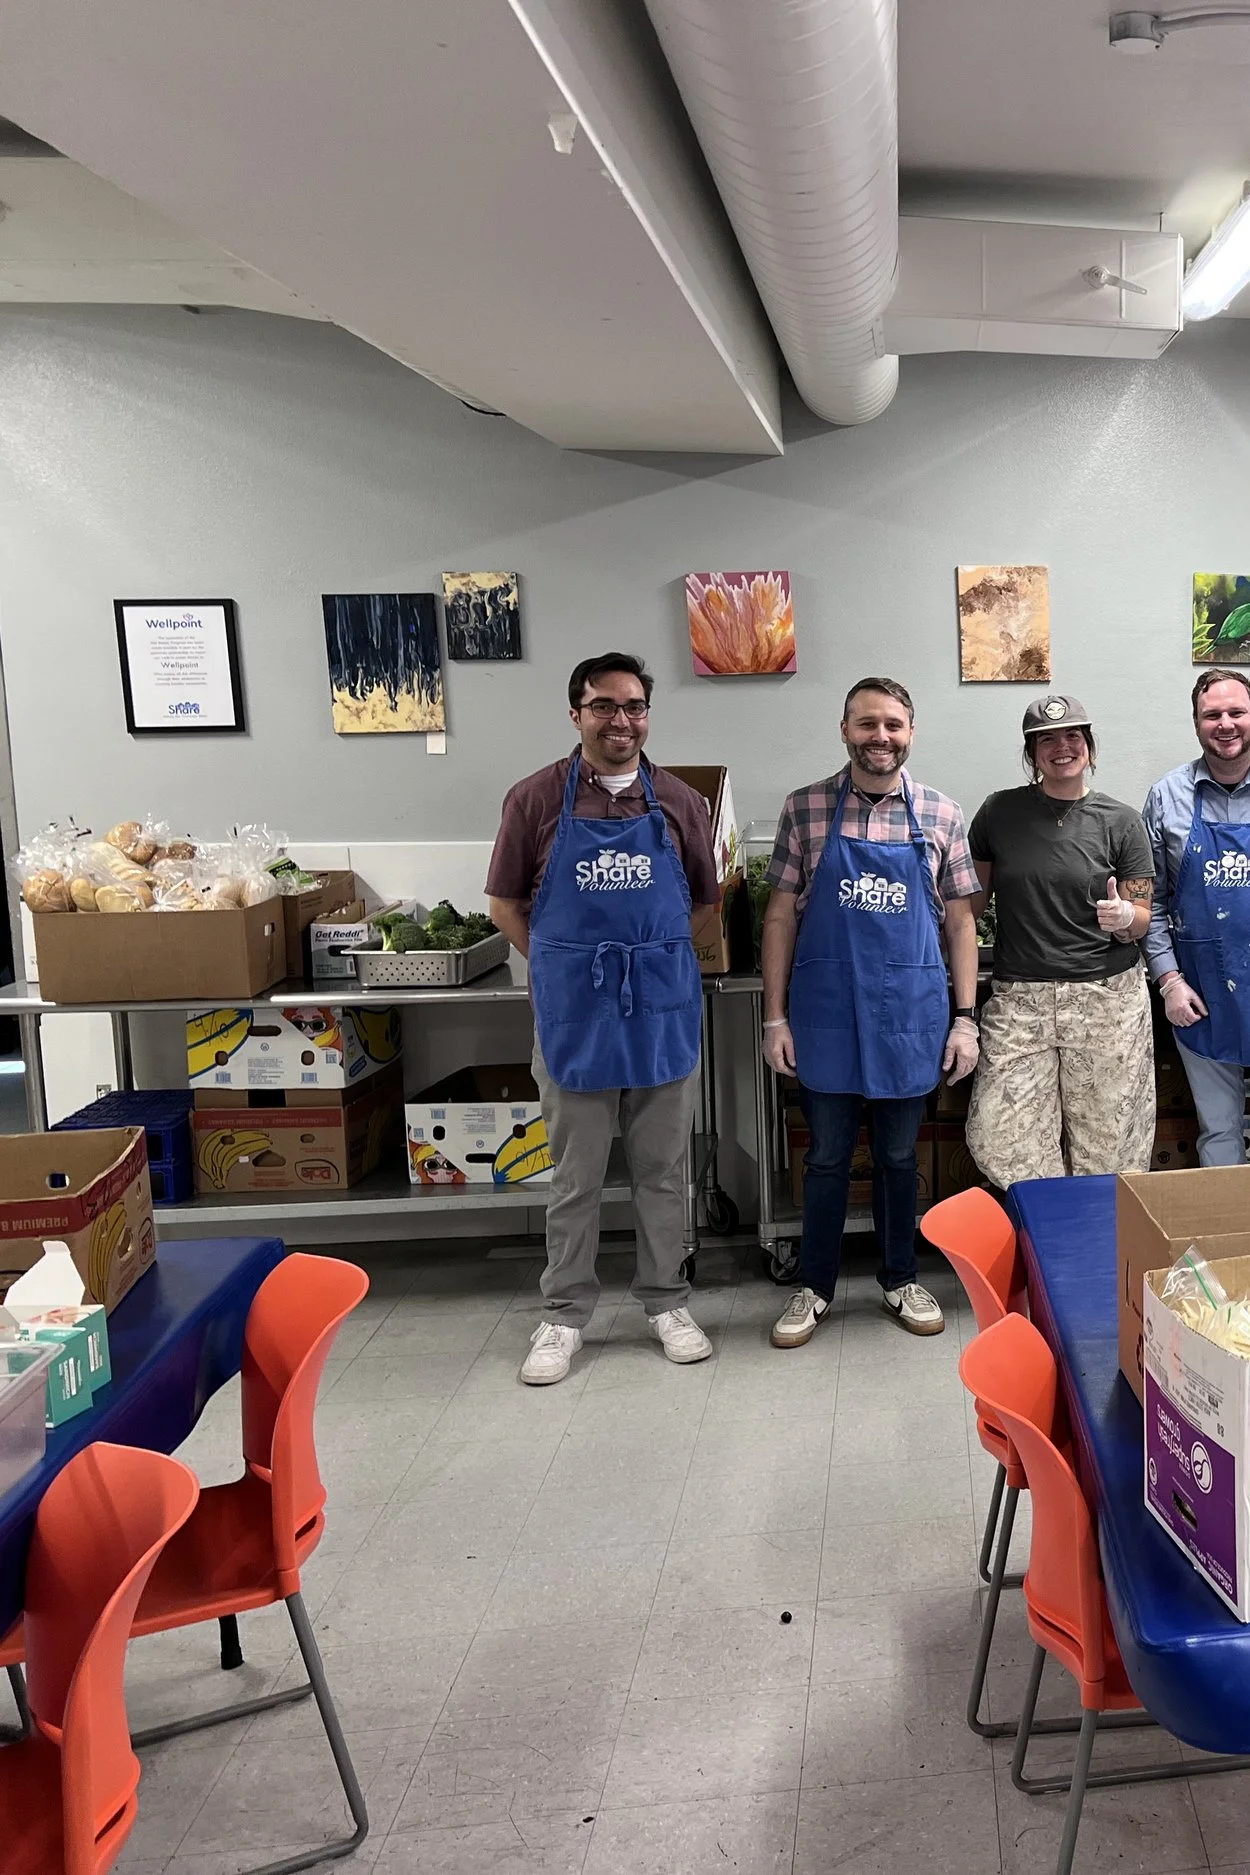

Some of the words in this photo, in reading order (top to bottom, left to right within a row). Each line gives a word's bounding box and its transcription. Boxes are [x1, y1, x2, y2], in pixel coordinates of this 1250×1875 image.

[145, 618, 204, 630] Wellpoint
[160, 662, 199, 670] Wellpoint
[168, 703, 200, 714] Share
[575, 860, 652, 882] Share
[577, 879, 656, 892] Volunteer
[838, 878, 906, 906] Share
[838, 896, 908, 914] Volunteer
[301, 1168, 331, 1182] Dole
[12, 1216, 69, 1232] PREMIUM
[1157, 1404, 1180, 1442] growers
[1158, 1422, 1190, 1471] superfresh
[1207, 1560, 1234, 1595] ORGANIC
